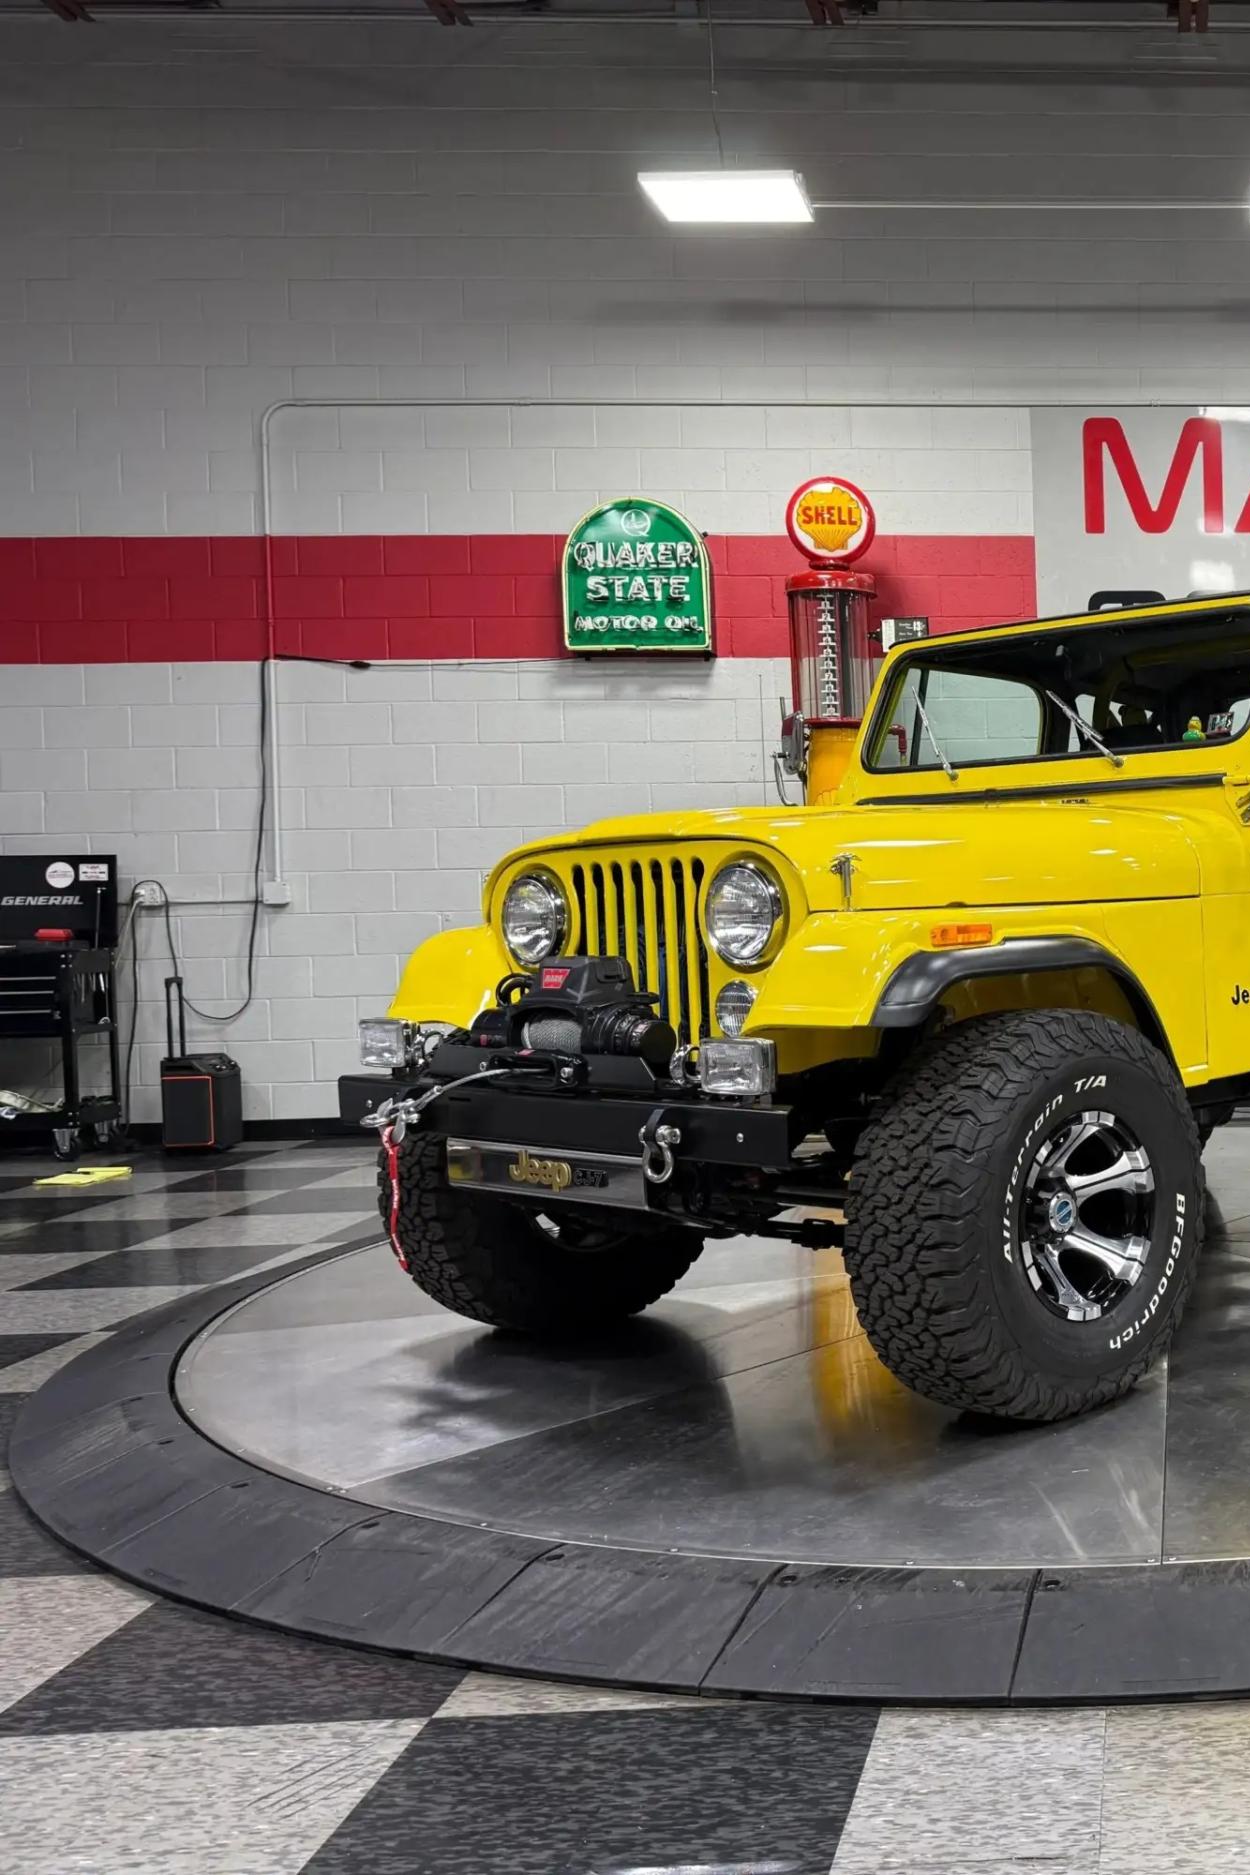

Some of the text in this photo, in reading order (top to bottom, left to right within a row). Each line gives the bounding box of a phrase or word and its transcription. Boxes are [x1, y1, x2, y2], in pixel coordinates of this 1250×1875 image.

[800, 505, 857, 526] SHELL
[573, 541, 699, 572] QUAKER
[586, 575, 690, 602] STATE
[574, 614, 658, 632] MOTOR
[1, 896, 84, 906] GENERAL
[508, 1150, 572, 1192] Jeep
[1002, 1075, 1107, 1264] All-Terrain T/A
[1109, 1192, 1186, 1350] BFGoodrich
